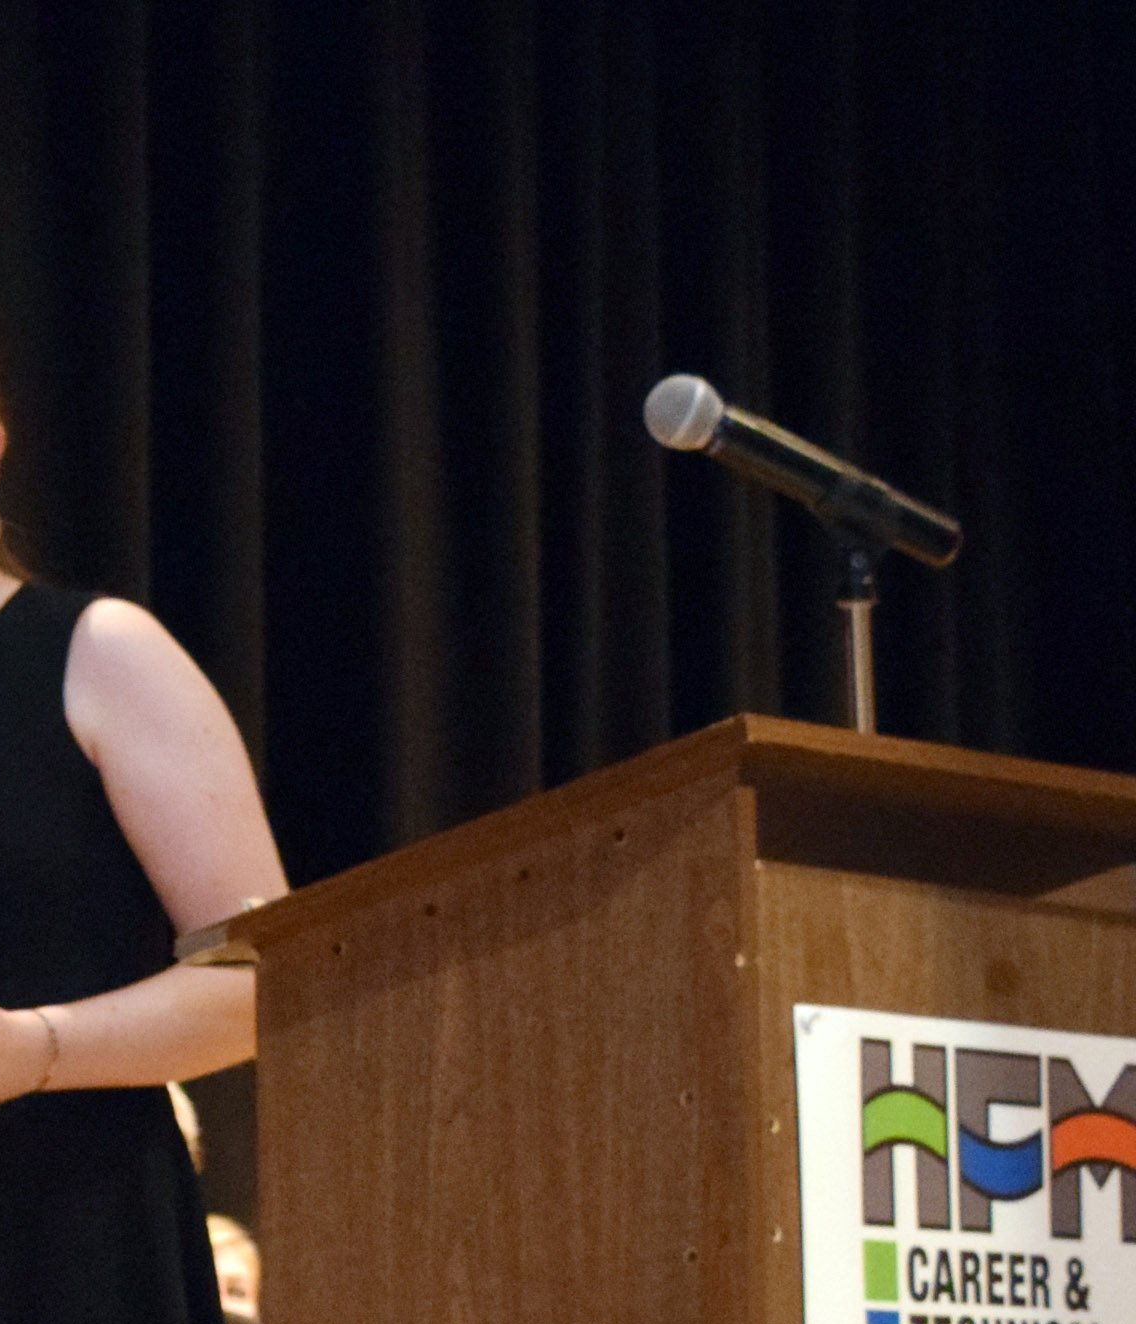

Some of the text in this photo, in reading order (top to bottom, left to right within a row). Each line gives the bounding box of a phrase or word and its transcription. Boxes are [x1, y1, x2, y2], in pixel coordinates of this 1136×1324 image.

[861, 1037, 1136, 1243] HFM
[908, 1247, 1090, 1311] CAREER &
